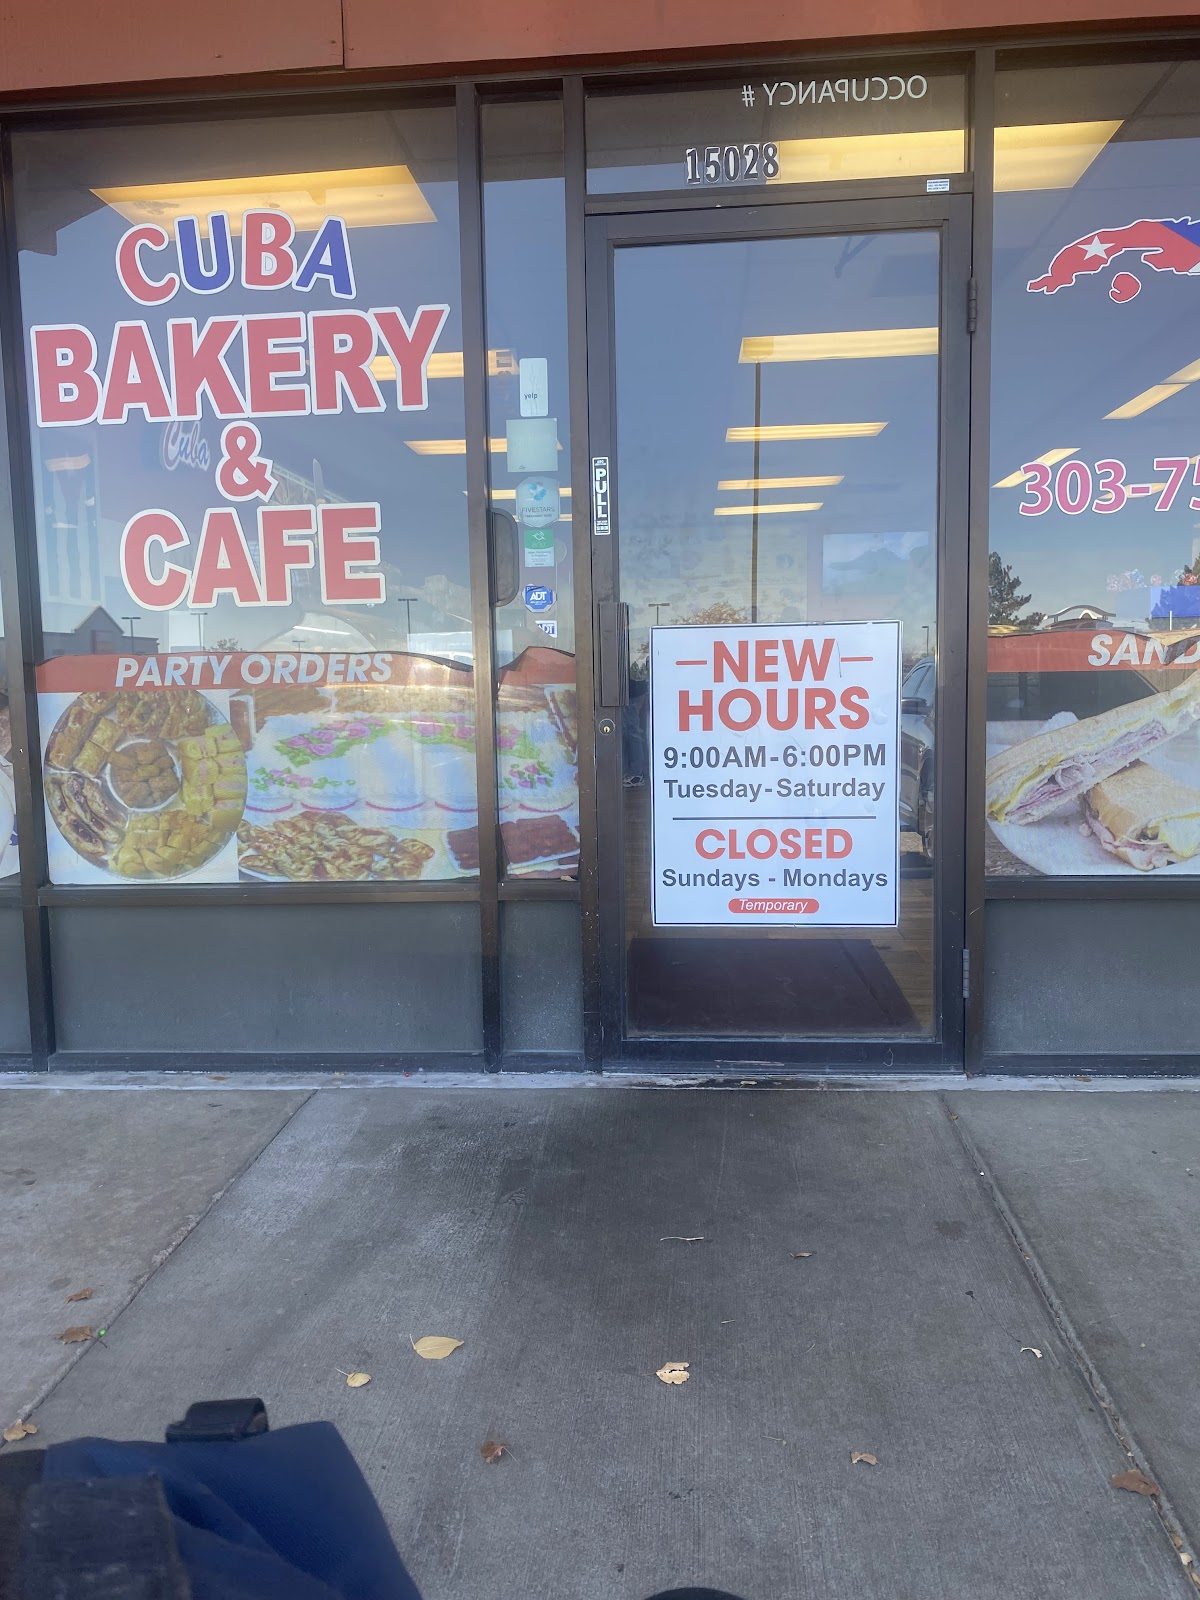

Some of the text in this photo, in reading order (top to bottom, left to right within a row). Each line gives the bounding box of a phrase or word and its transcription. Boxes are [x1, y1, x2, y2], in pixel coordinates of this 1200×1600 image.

[686, 141, 780, 185] 15028
[115, 209, 357, 306] CUBA
[30, 304, 450, 428] BAKERY
[524, 392, 538, 400] yelp
[162, 420, 211, 471] Cuba
[215, 420, 279, 502] &
[595, 468, 608, 518] PULL
[119, 502, 387, 611] CAFE
[530, 591, 547, 601] ADT
[115, 653, 393, 688] PARTY ORDERS
[713, 638, 835, 683] NEW
[678, 686, 870, 732] HOURS
[663, 743, 886, 769] 9:00AM-6:00PM
[695, 828, 853, 860] CLOSED
[662, 868, 760, 891] Sundays
[783, 868, 888, 891] Mondays
[739, 899, 808, 914] Temporary
